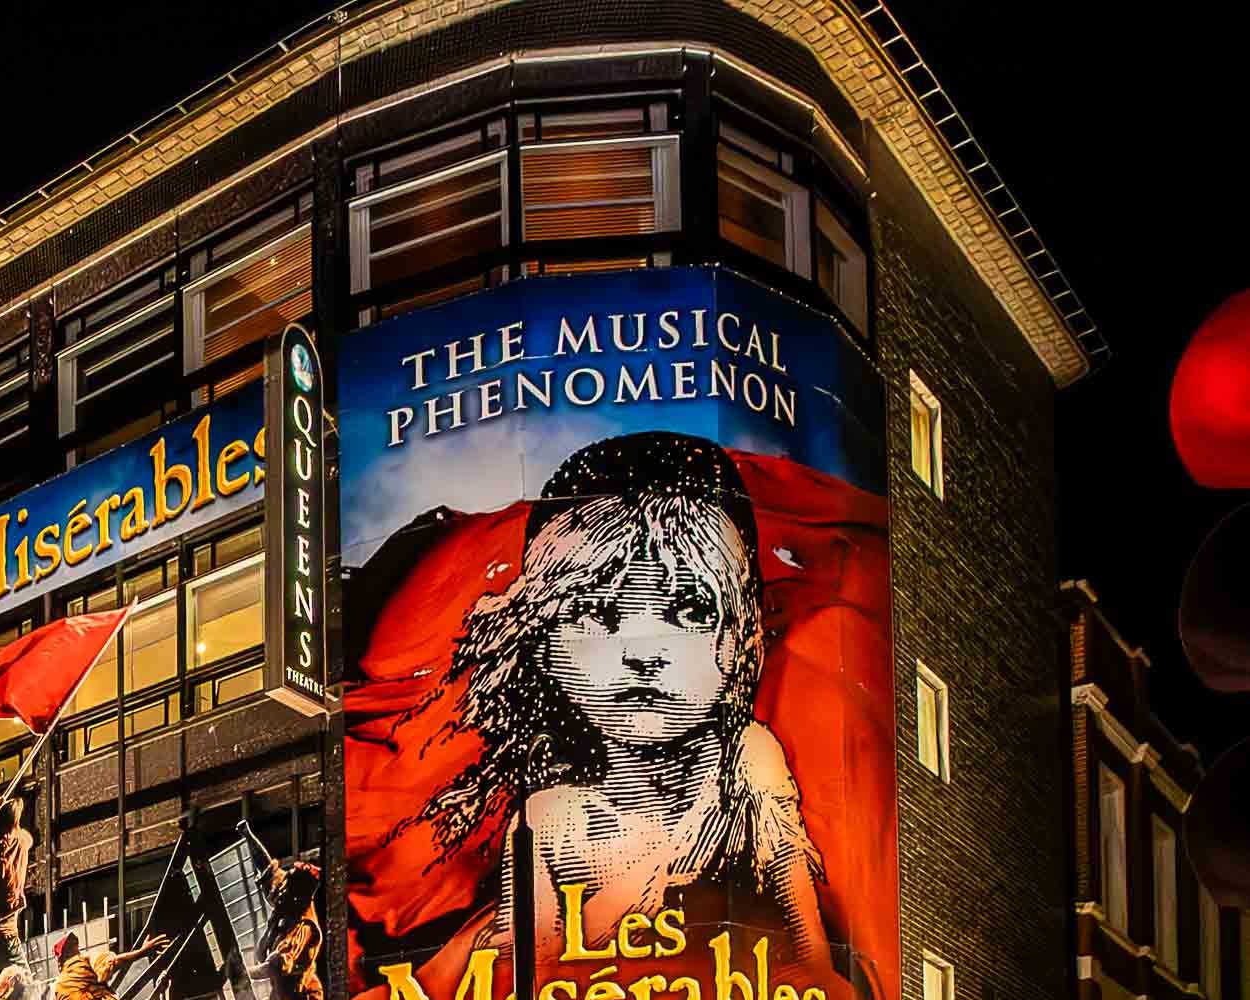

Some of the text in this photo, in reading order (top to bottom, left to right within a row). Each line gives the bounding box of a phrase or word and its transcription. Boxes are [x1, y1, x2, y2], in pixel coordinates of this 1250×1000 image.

[402, 308, 788, 391] THE MUSICAL
[386, 359, 797, 448] PHENOMENON
[292, 395, 317, 669] QUEENS
[285, 665, 325, 698] THEATRE
[559, 882, 687, 963] Les
